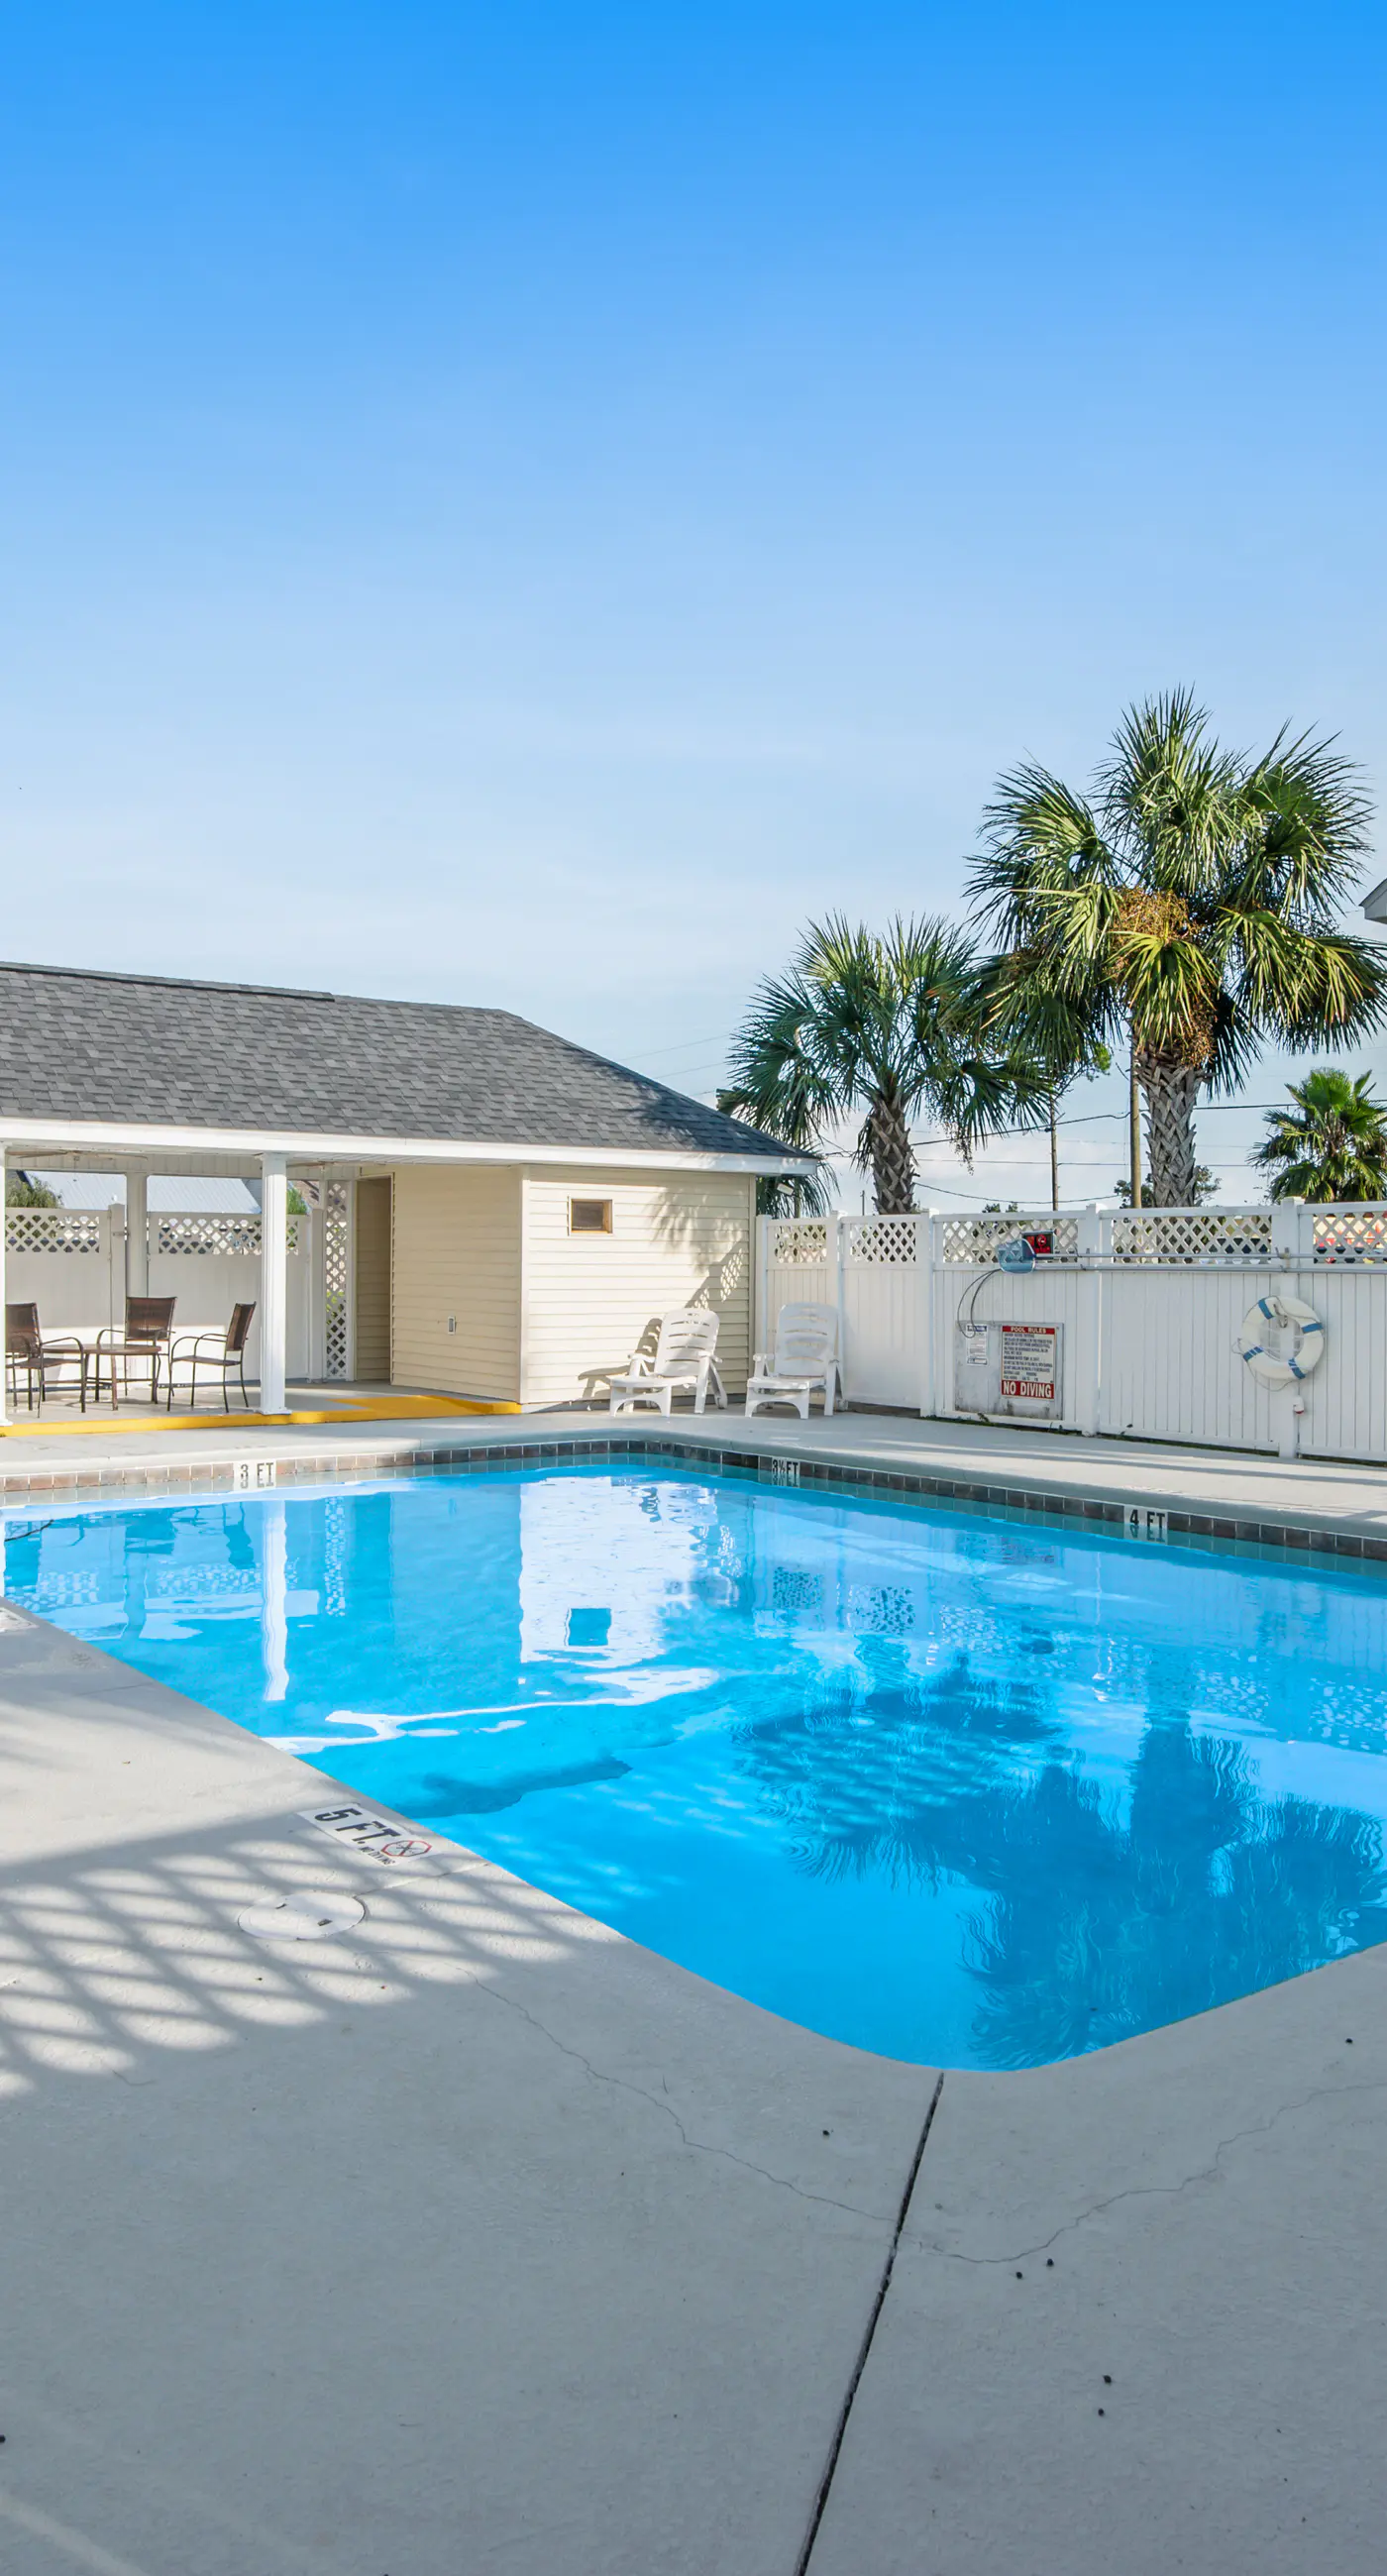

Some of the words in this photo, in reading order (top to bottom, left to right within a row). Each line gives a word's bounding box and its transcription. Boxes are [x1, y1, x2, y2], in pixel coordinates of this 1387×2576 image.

[1003, 1381, 1016, 1395] NO
[1020, 1382, 1052, 1398] DIVING
[241, 1463, 249, 1477] 3
[257, 1462, 274, 1476] FT
[787, 1461, 799, 1474] FT
[1130, 1509, 1139, 1526] 4
[1147, 1511, 1166, 1529] FT
[314, 1808, 363, 1822] 5
